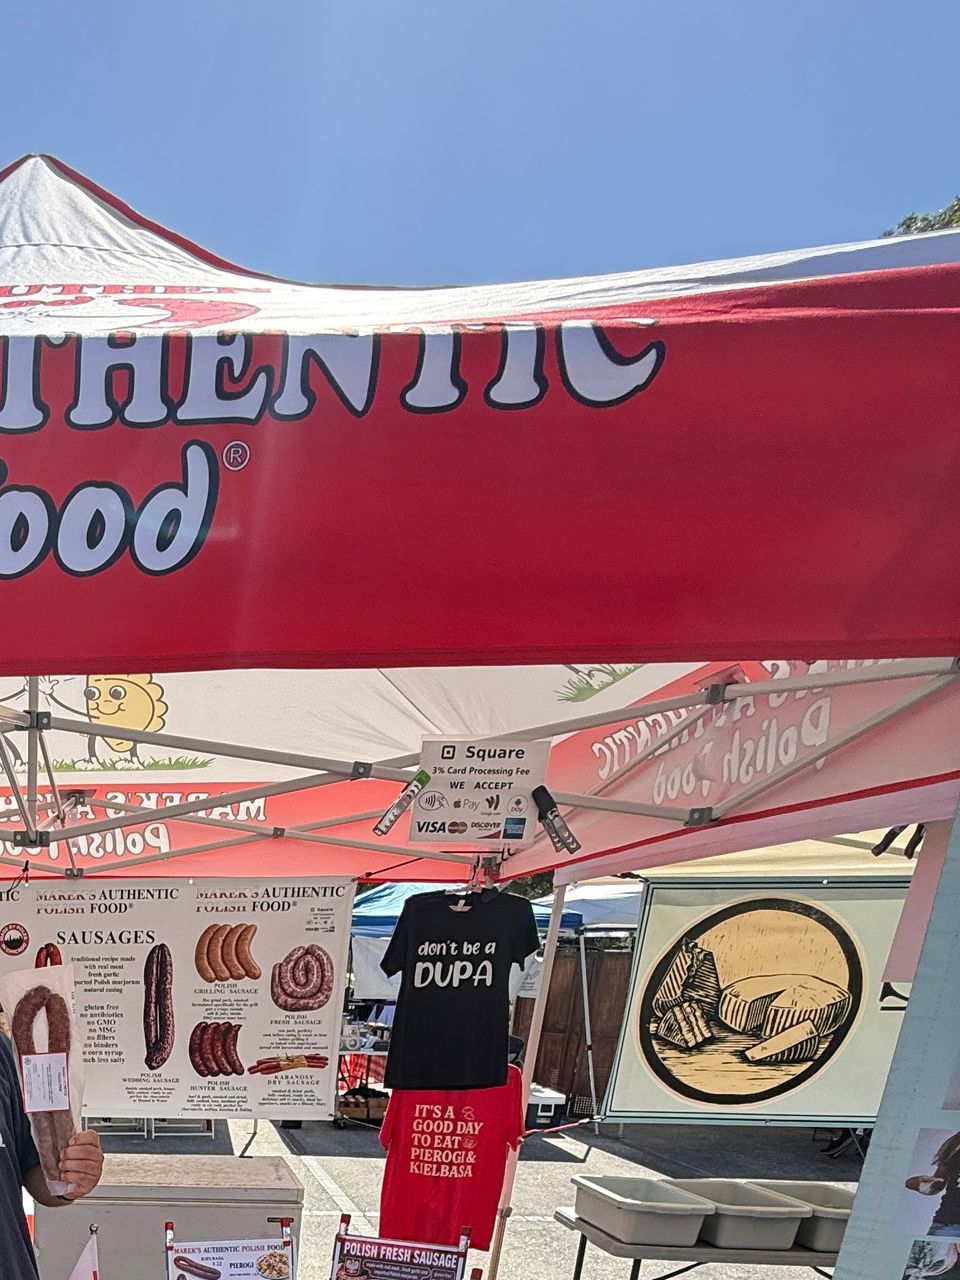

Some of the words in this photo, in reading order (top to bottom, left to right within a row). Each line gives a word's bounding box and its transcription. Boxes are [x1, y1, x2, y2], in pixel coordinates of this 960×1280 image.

[465, 745, 526, 762] Square
[431, 766, 445, 775] 3%
[447, 766, 467, 775] Card
[468, 766, 514, 777] Processing
[515, 767, 530, 776] Fee
[449, 781, 466, 790] WE
[473, 781, 514, 791] ACCEPT
[416, 821, 447, 834] VISA
[470, 821, 502, 829] DISCOVER
[98, 888, 180, 901] AUTHENTIC
[261, 886, 346, 898] AUTHENTIC
[56, 930, 156, 946] SAUSAGES
[417, 940, 458, 957] don't
[462, 939, 481, 956] be
[484, 940, 497, 956] a
[103, 971, 121, 979] garlic
[413, 960, 493, 990] DUPA
[84, 1003, 105, 1012] gluten
[106, 1003, 120, 1011] free
[89, 1011, 124, 1019] antibiotics
[96, 1019, 117, 1027] GMO
[98, 1026, 117, 1034] MSG
[104, 1050, 124, 1058] syrup
[414, 1103, 442, 1119] IT'S
[443, 1105, 456, 1120] A
[412, 1118, 456, 1134] GOOD
[456, 1121, 484, 1136] DAY
[411, 1133, 432, 1148] TO
[433, 1134, 463, 1150] EAT
[410, 1147, 466, 1164] PIEROGI
[408, 1161, 474, 1179] KIELBASA
[203, 1245, 241, 1255] AUTHENTIC
[241, 1244, 266, 1253] POLISH
[343, 1240, 379, 1260] POLISH
[379, 1245, 412, 1264] FRESH
[412, 1250, 458, 1269] SAUSAGE
[229, 1261, 255, 1270] PIEROGI
